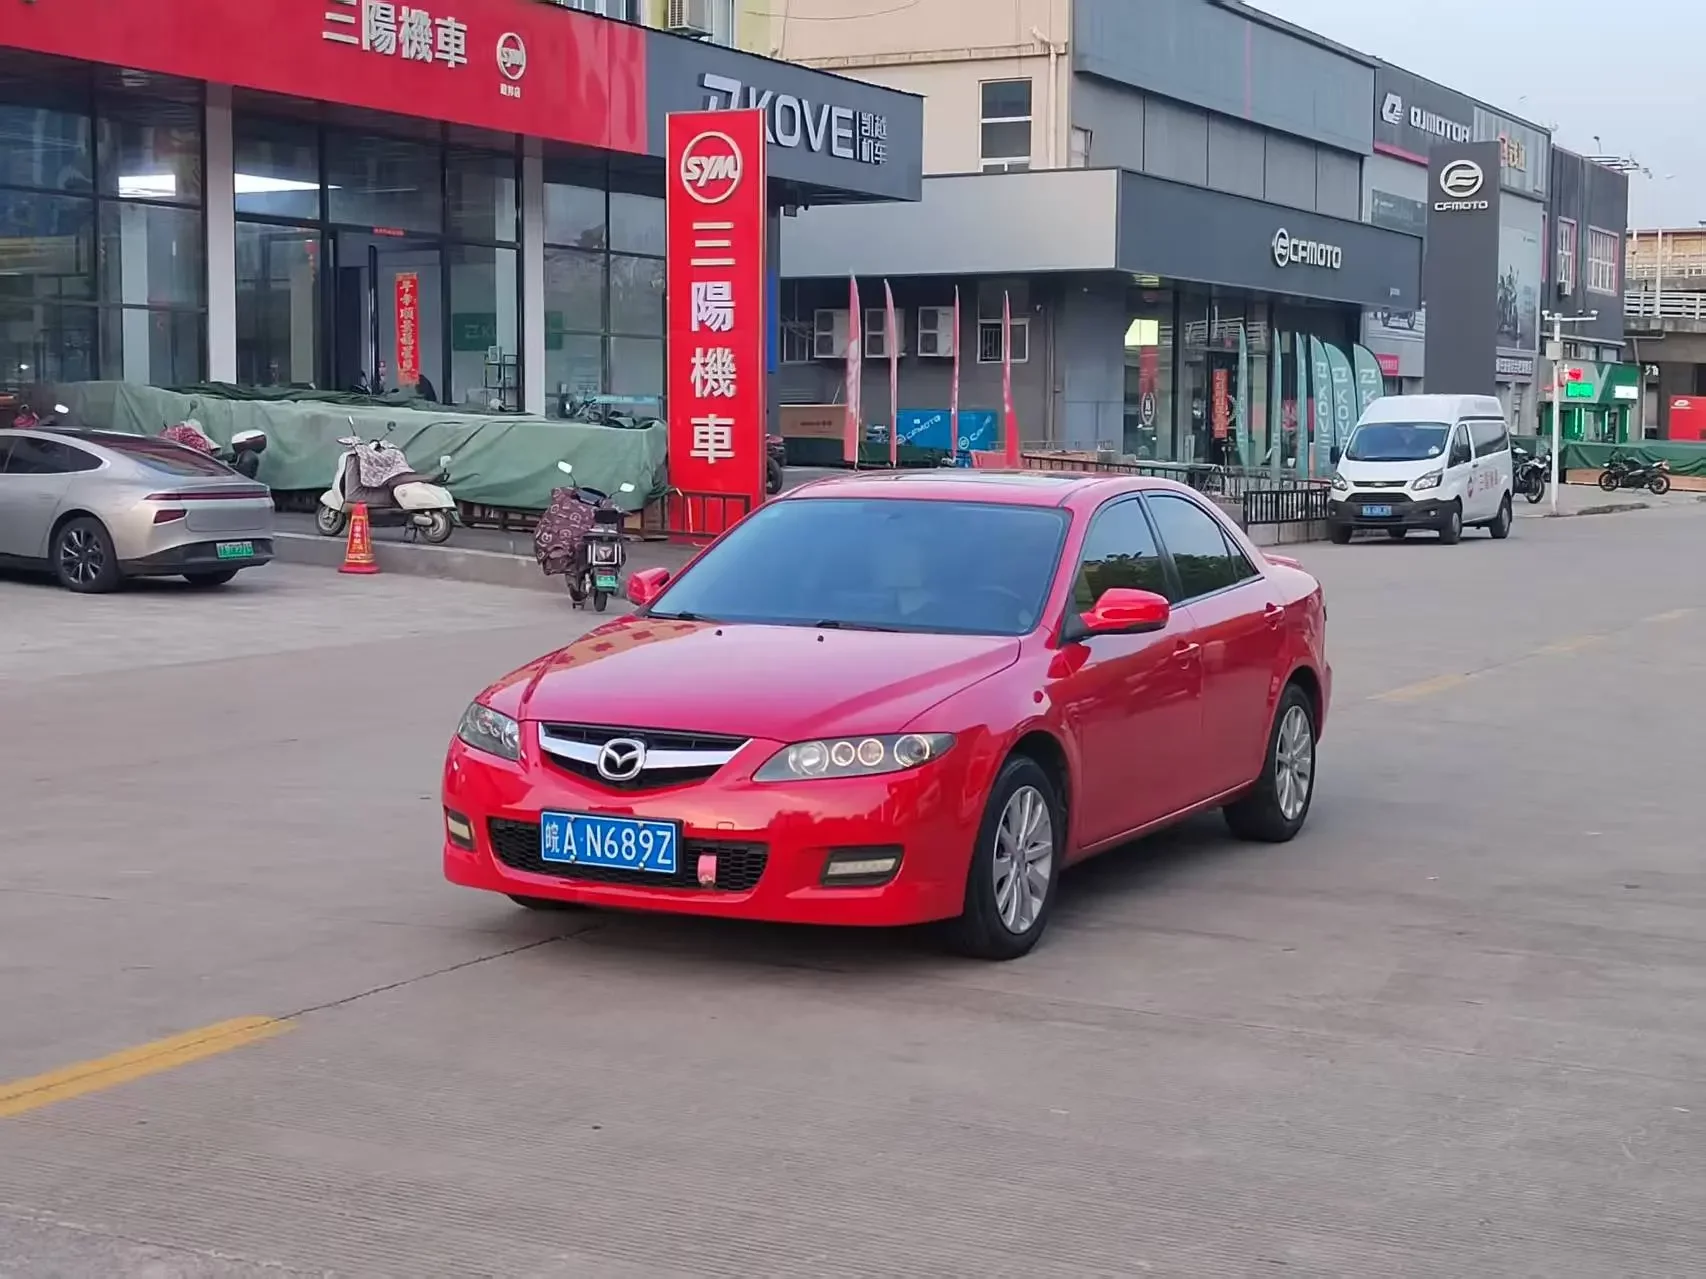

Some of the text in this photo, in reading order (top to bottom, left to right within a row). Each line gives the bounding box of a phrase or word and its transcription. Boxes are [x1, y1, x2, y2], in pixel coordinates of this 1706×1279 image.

[322, 0, 467, 68] 三陽機車
[749, 86, 854, 159] KOVE
[862, 112, 887, 139] 凯越
[862, 138, 887, 164] 机车
[684, 155, 737, 187] SYM
[1434, 200, 1488, 211] CFMOTO
[1290, 238, 1342, 269] CFMOTO
[690, 221, 736, 464] 三陽機車
